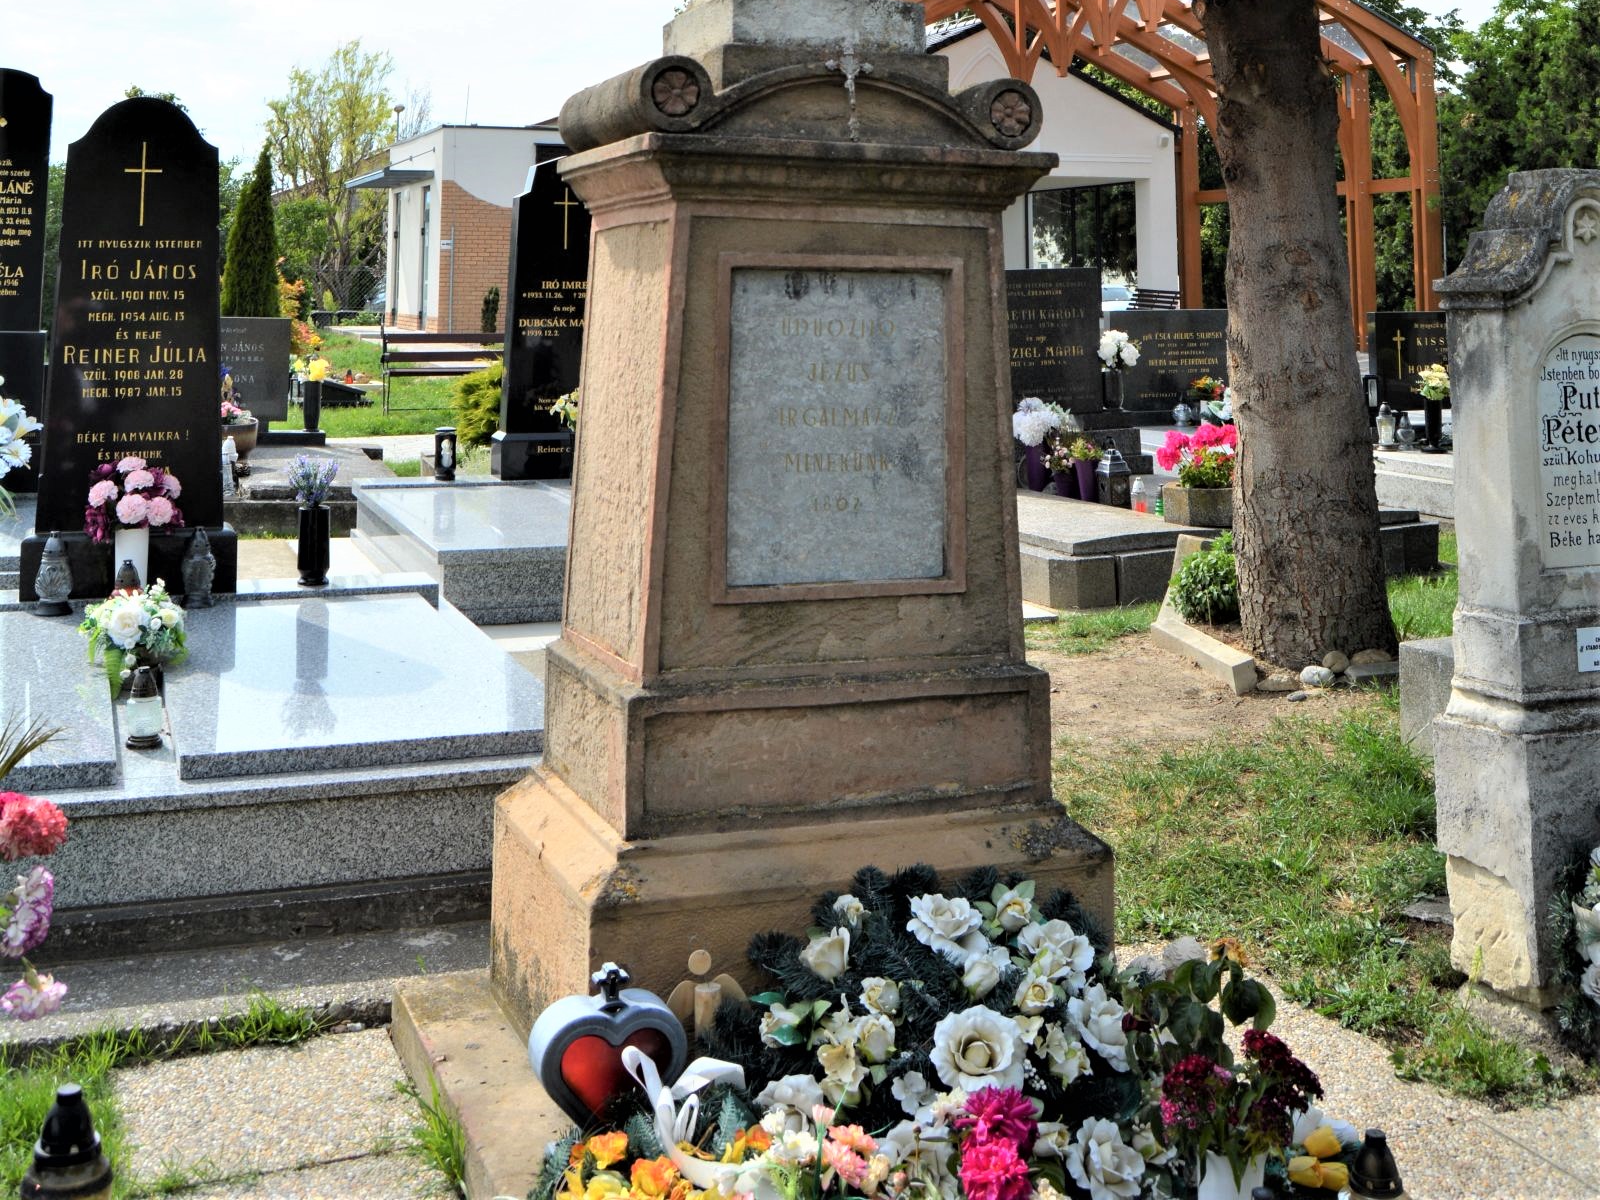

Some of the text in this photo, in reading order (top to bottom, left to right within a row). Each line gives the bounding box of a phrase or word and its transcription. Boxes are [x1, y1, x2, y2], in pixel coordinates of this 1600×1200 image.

[78, 240, 202, 249] ITT NYUGSZIK ISTENBEN
[81, 259, 197, 280] IRÓ JÁNOS
[542, 279, 560, 289] IRÓ
[121, 290, 144, 302] 1901
[149, 290, 170, 301] NOV.
[174, 290, 185, 300] 15
[562, 305, 576, 313] neje
[88, 311, 185, 322] MEGH. 1954 AUG. 13
[518, 316, 568, 328] DUBCSÁK
[116, 328, 162, 340] ÉS NEJE
[231, 341, 265, 352] JÁNOS
[1416, 336, 1446, 347] KISS
[63, 341, 207, 364] REINER JÚLIA
[1045, 343, 1084, 357] MÁRIA
[115, 370, 140, 382] 1908
[144, 370, 168, 380] JAN.
[169, 369, 184, 380] 28
[82, 386, 182, 400] MEGH. 1987 JAN. 15
[77, 430, 106, 443] BÉKE
[113, 431, 181, 442] HAMVAIKRA
[97, 448, 111, 461] ÉS
[537, 445, 564, 454] Reiner
[1550, 530, 1583, 549] Béke
